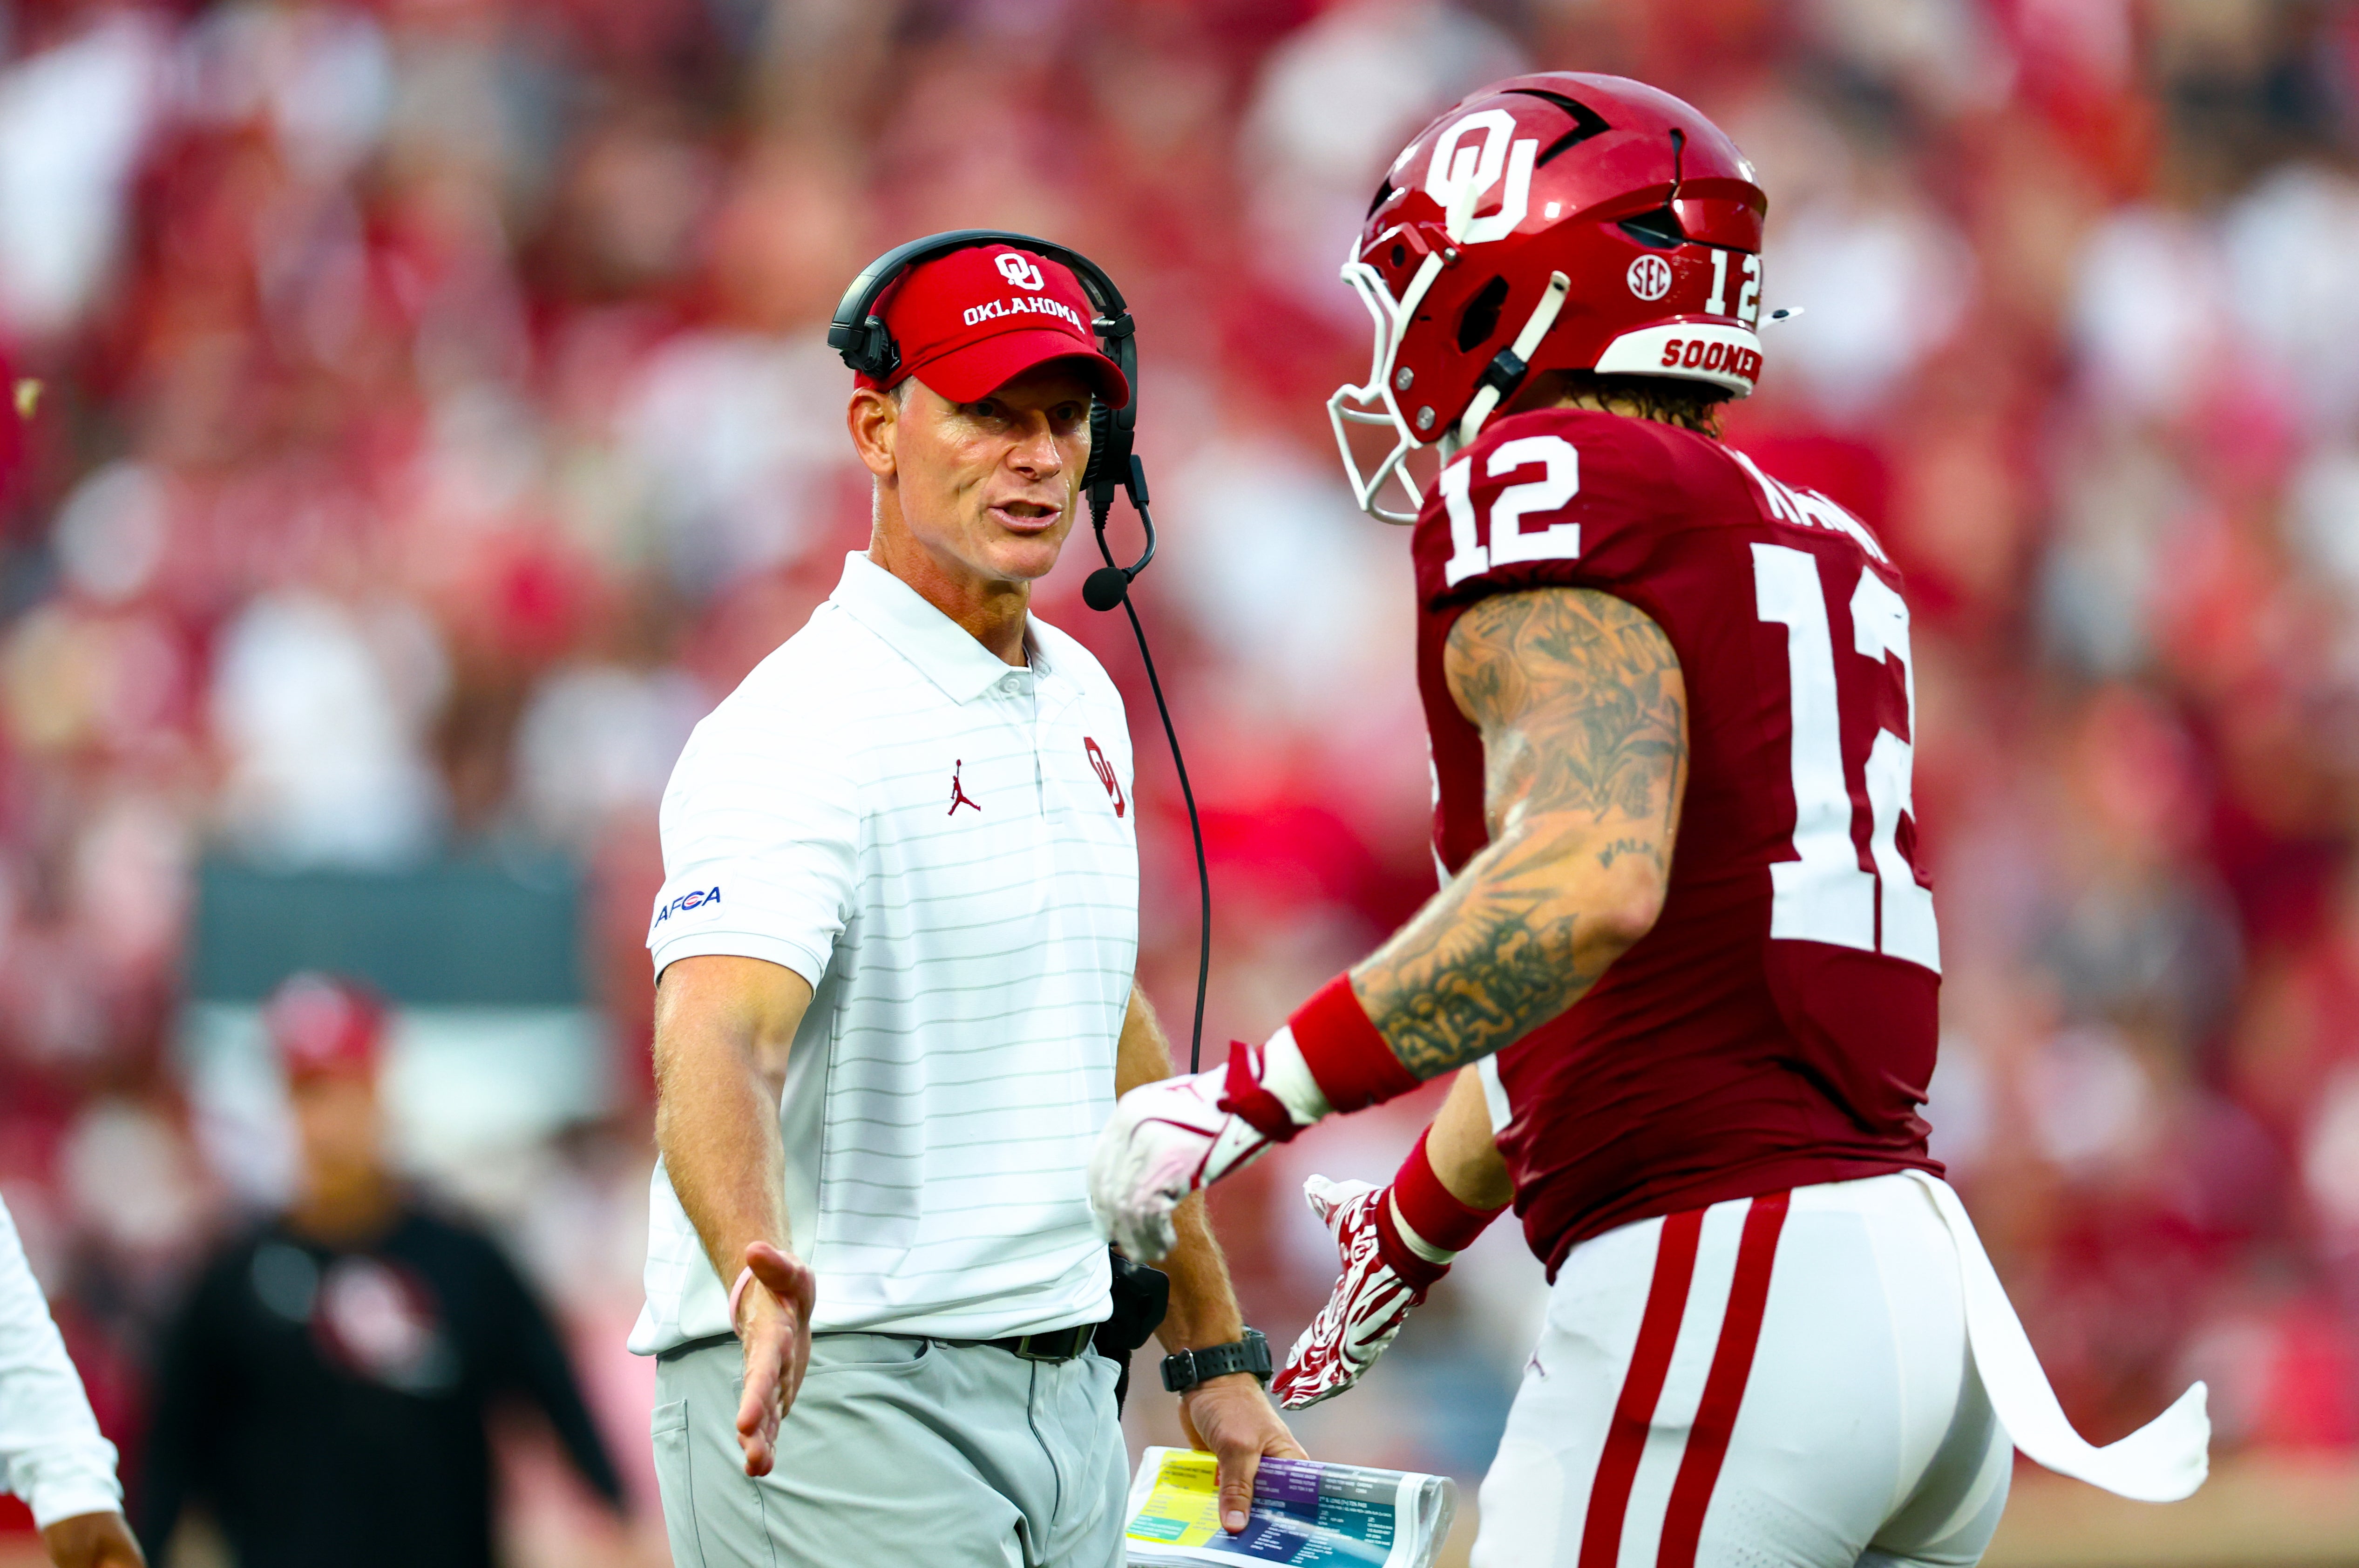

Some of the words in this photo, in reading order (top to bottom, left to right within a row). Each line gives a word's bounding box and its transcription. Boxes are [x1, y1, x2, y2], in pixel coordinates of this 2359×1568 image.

[1424, 109, 1539, 244] OU
[994, 253, 1044, 291] OU
[1633, 258, 1667, 297] SEC
[1704, 248, 1762, 322] 12
[963, 297, 1085, 335] OKLAHOMA
[1439, 435, 1581, 589] 12
[1750, 542, 1942, 974] 12
[654, 886, 720, 928] AFCA
